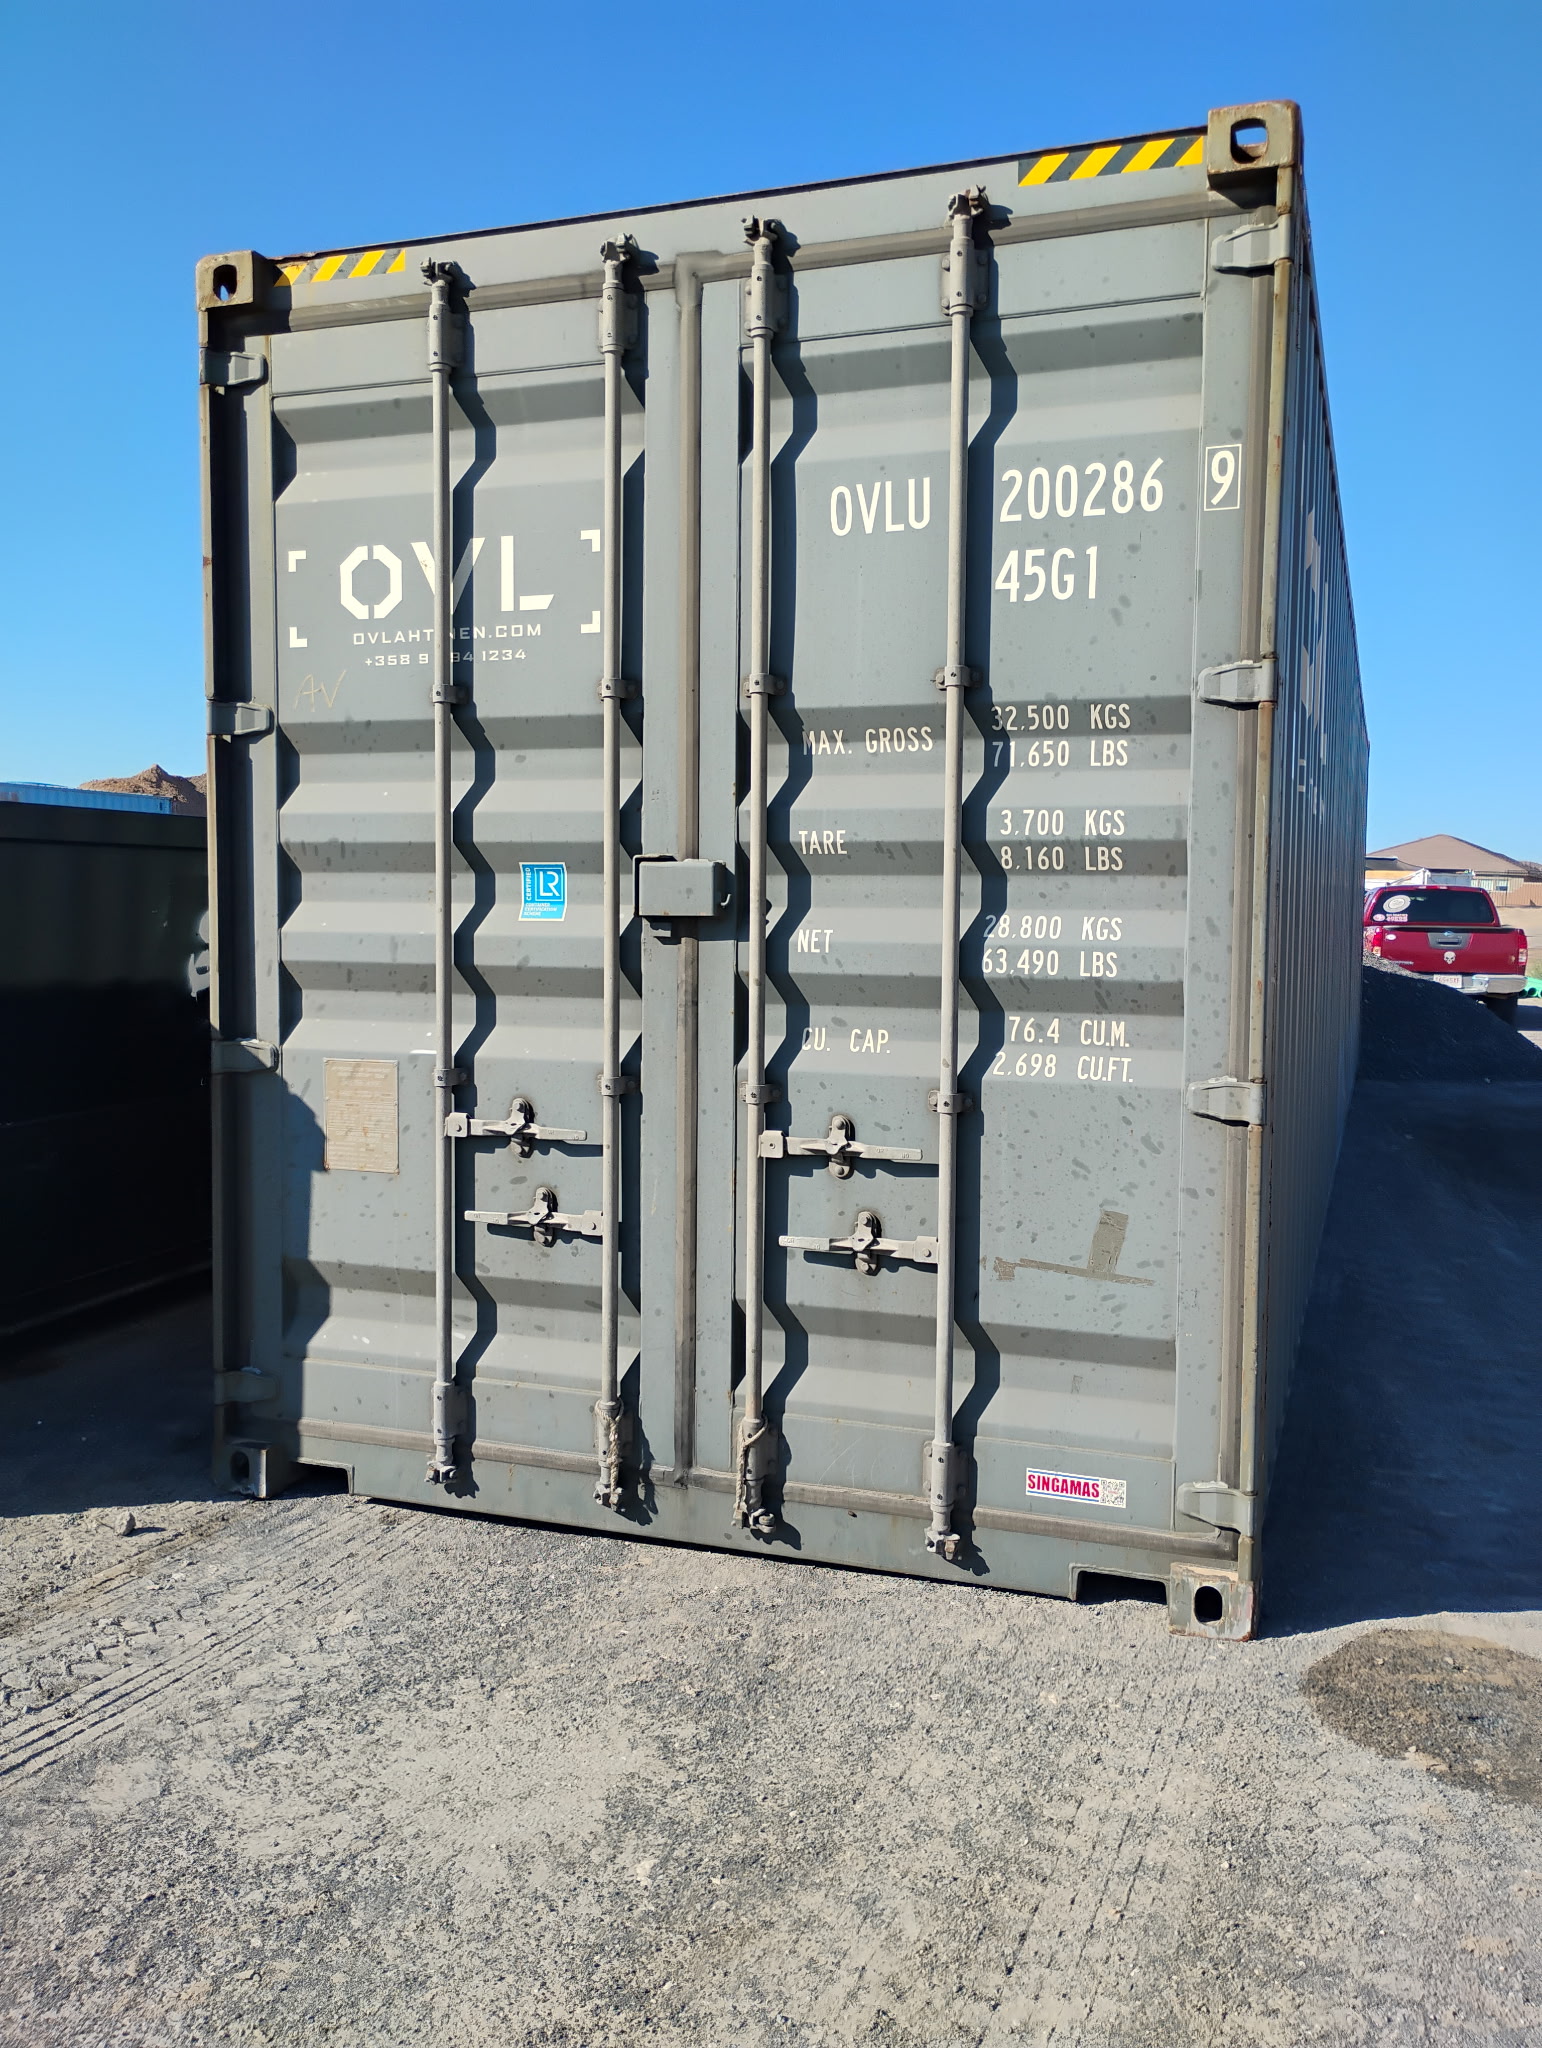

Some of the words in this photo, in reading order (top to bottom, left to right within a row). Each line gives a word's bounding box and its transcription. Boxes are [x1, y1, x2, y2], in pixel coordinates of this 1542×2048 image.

[830, 477, 930, 536] OVLU
[1000, 457, 1164, 522] 200286
[1211, 451, 1235, 505] 9
[340, 535, 554, 620] OVL
[995, 546, 1097, 602] 45G1
[353, 624, 542, 646] OVLAHTEN.COM
[365, 653, 410, 667] +358
[418, 653, 429, 664] 9
[482, 649, 527, 662] 1234
[991, 704, 1069, 731] 32,500
[1090, 703, 1131, 730] KGS
[802, 729, 852, 755] MAX.
[865, 727, 934, 753] GROSS
[991, 740, 1069, 767] 71,650
[1090, 739, 1128, 767] LBS
[1000, 809, 1064, 836] 3,700
[1084, 809, 1125, 836] KGS
[799, 829, 847, 855] TARE
[1000, 845, 1064, 871] 8,160
[1084, 846, 1123, 871] LBS
[540, 871, 560, 896] LR
[797, 928, 834, 953] NET
[983, 914, 1062, 940] 28,800
[1081, 916, 1122, 941] KGS
[981, 948, 1059, 976] 63,490
[1079, 950, 1118, 977] LBS
[802, 1027, 831, 1052] CU.
[849, 1029, 891, 1054] CAP.
[1008, 1016, 1060, 1044] 76.4
[1080, 1019, 1130, 1048] CU.M.
[992, 1051, 1057, 1078] 2,698
[1076, 1055, 1134, 1083] CU.FT.
[1027, 1474, 1100, 1498] SINGAMAS
